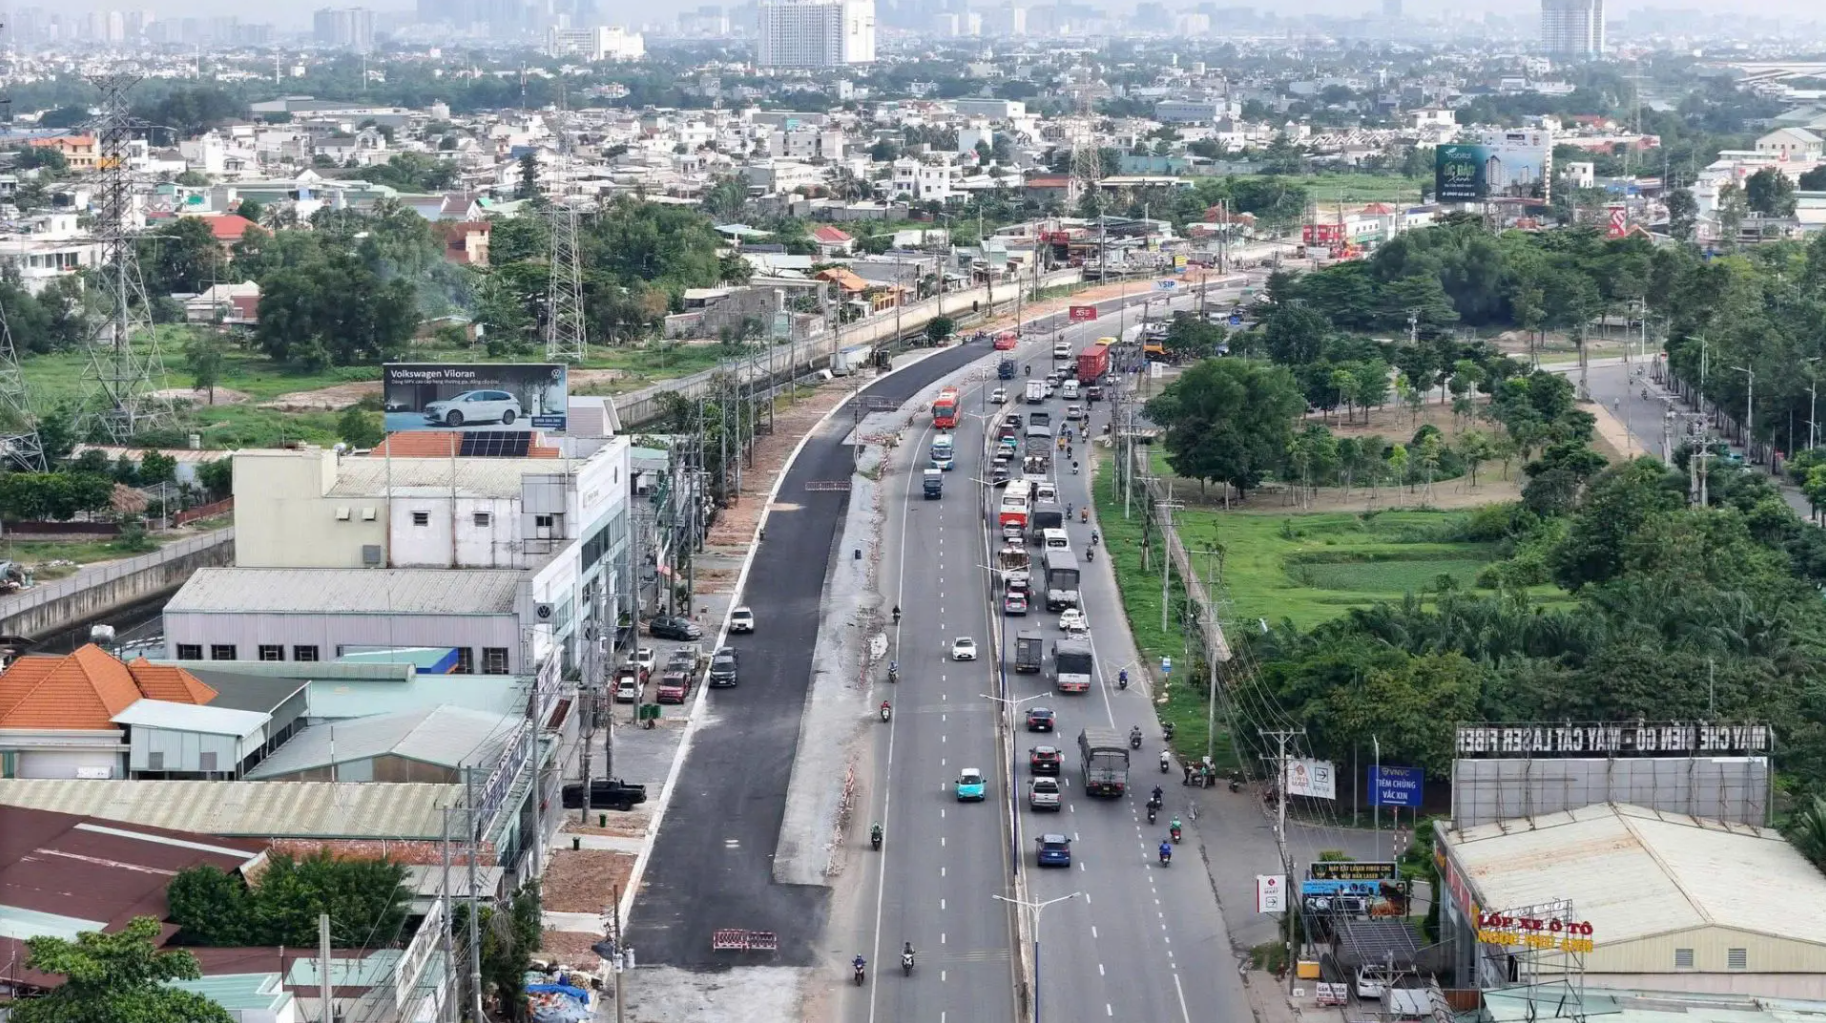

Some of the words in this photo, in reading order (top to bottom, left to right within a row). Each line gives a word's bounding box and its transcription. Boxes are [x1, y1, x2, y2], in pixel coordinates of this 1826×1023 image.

[390, 370, 442, 379] Volkswagen
[444, 370, 475, 378] Viloran
[1396, 791, 1408, 799] XIN
[1518, 918, 1544, 930] XE
[1549, 916, 1562, 932] Ô
[1567, 921, 1594, 935] TÔ
